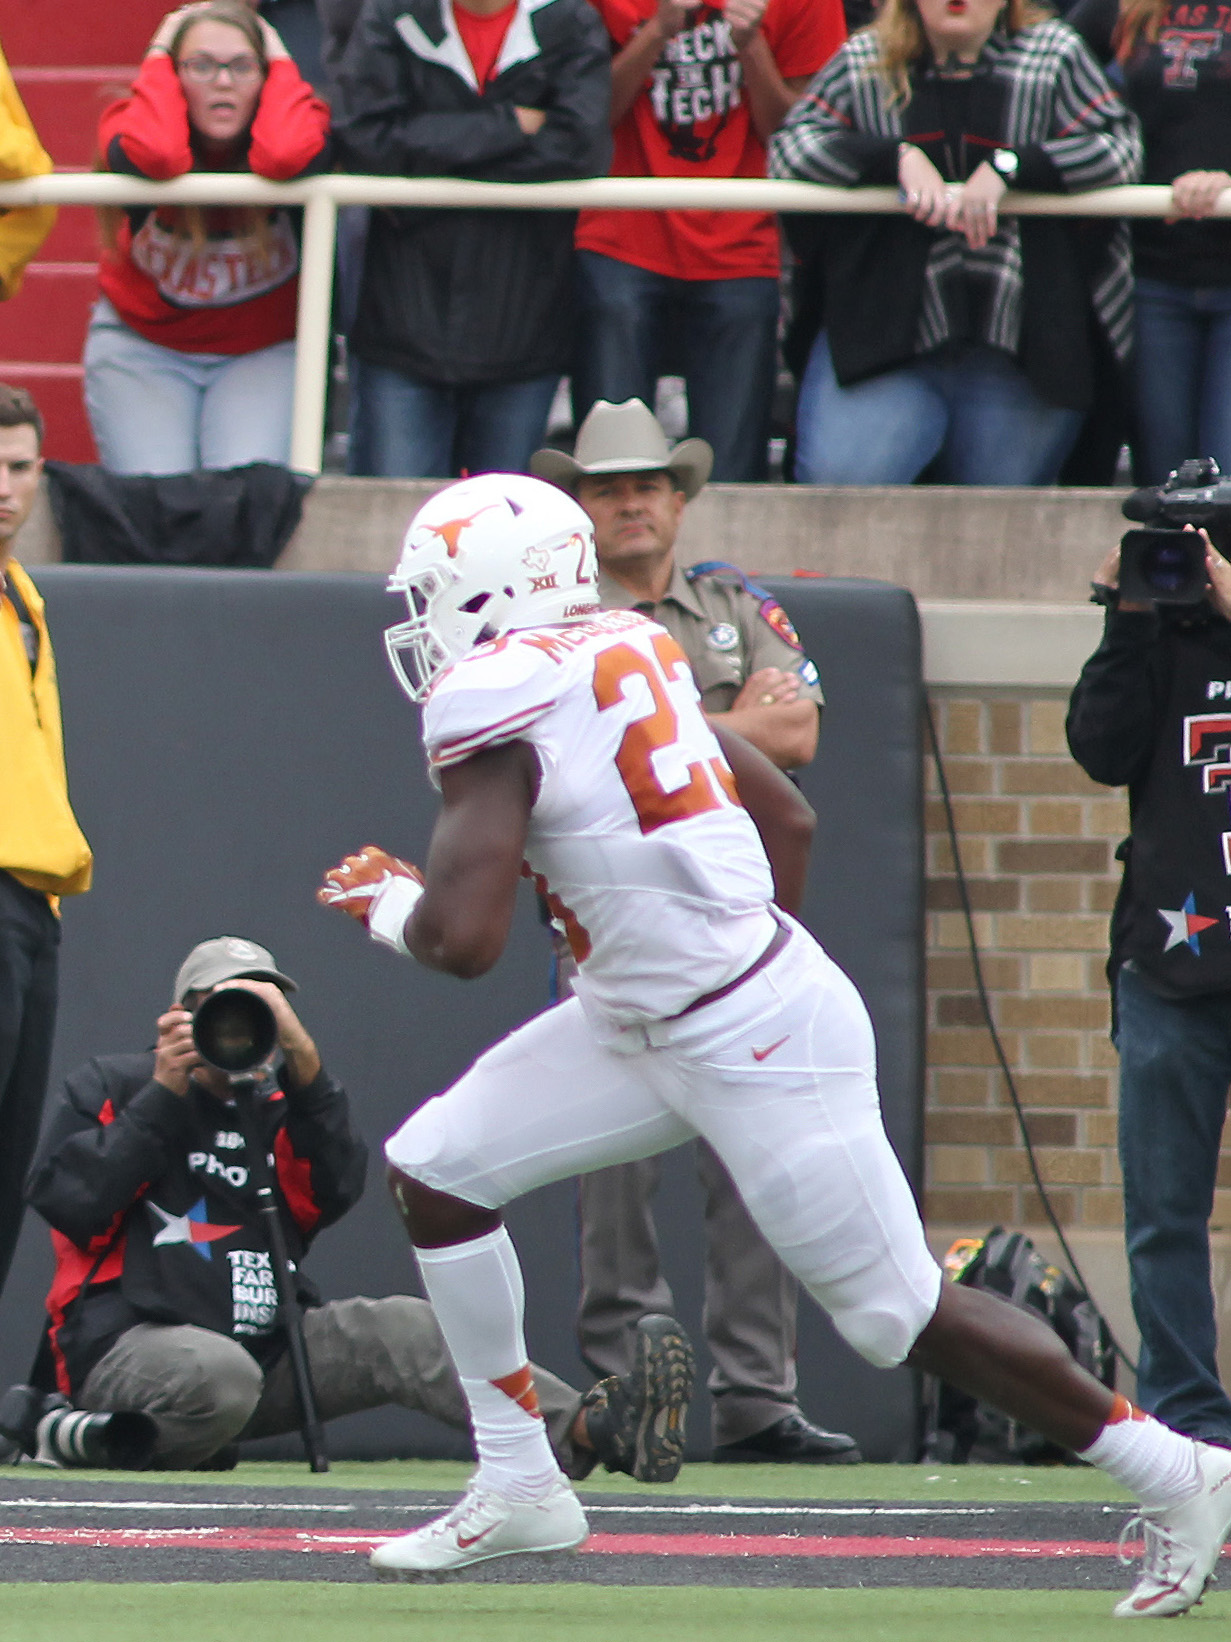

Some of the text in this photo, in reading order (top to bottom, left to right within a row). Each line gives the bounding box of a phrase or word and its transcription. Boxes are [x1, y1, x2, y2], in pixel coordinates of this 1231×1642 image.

[650, 60, 742, 124] TECH
[226, 1250, 271, 1269] TEX
[232, 1267, 273, 1286] FAR
[233, 1285, 278, 1305] BUR
